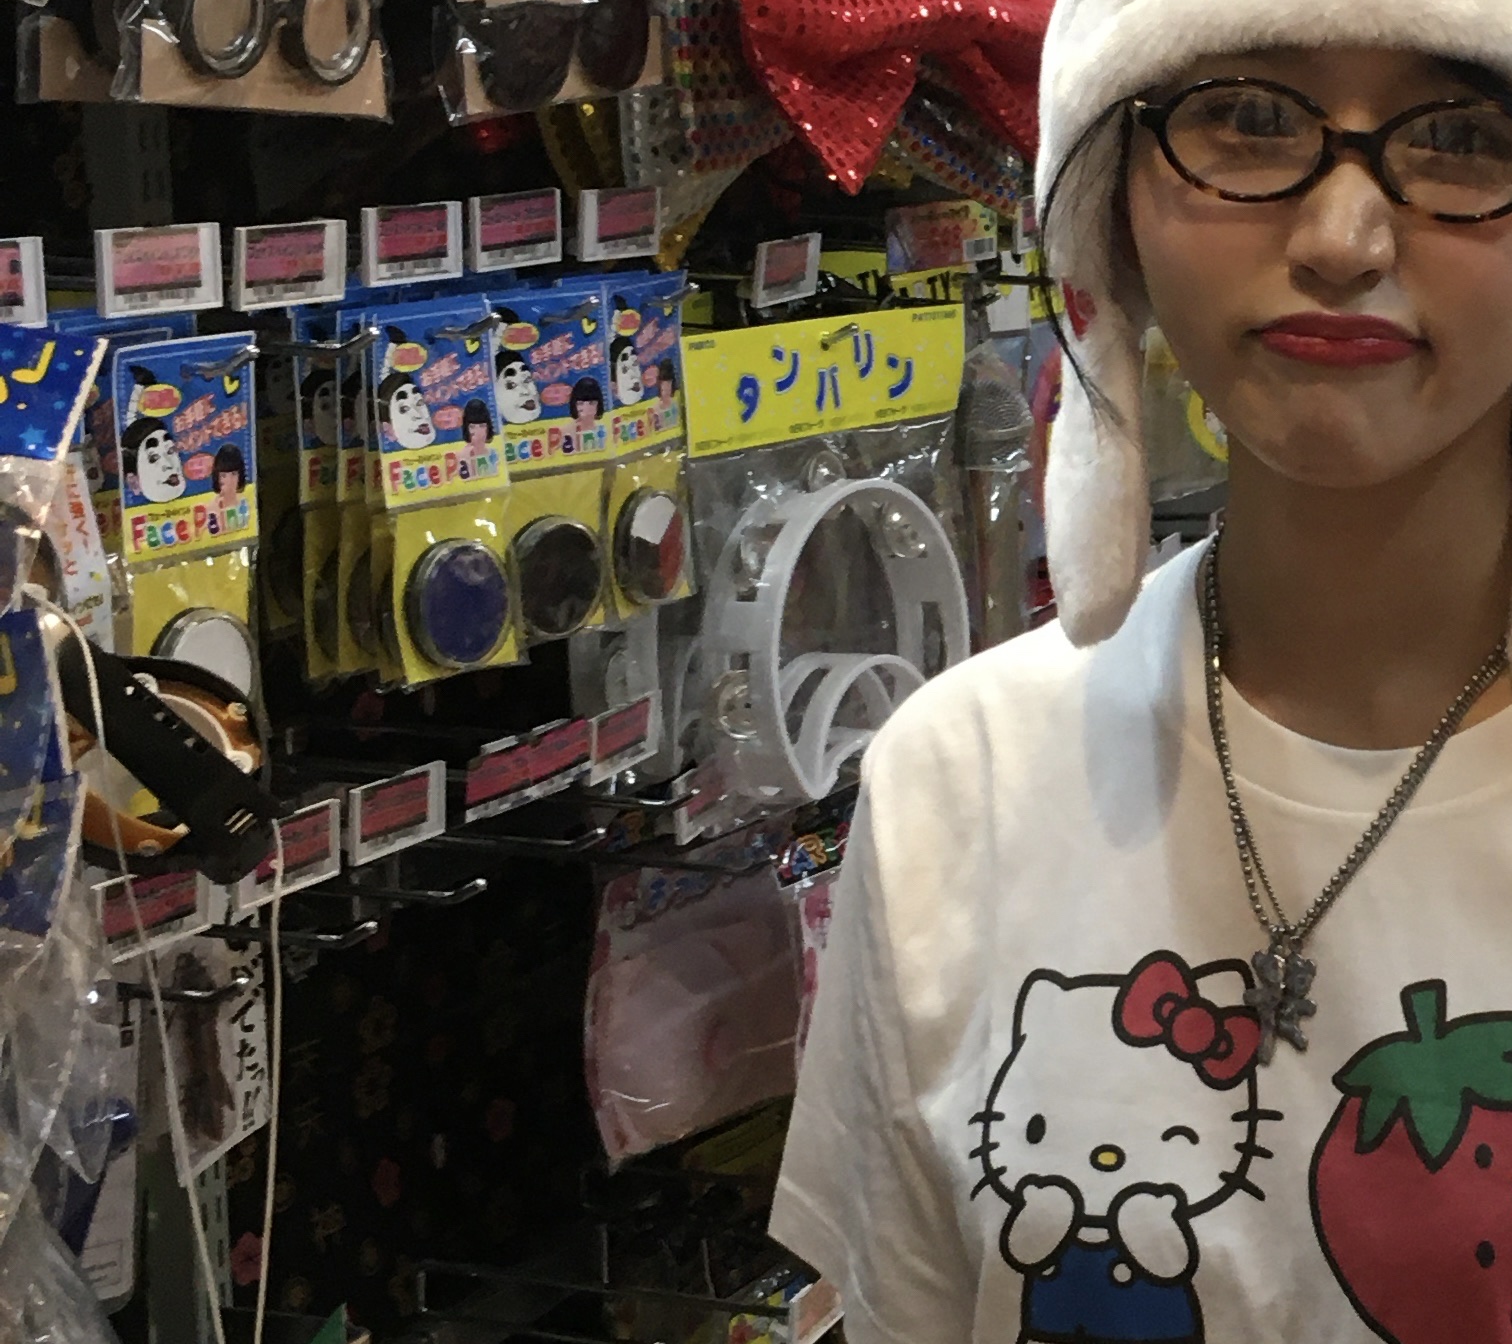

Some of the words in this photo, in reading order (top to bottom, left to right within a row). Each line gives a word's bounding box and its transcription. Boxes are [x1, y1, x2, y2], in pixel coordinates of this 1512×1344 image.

[736, 329, 915, 425] タンバリン
[546, 422, 607, 456] Paint
[389, 460, 443, 496] Face
[444, 445, 500, 483] Paint
[131, 514, 190, 553] Face
[193, 497, 251, 538] Paint
